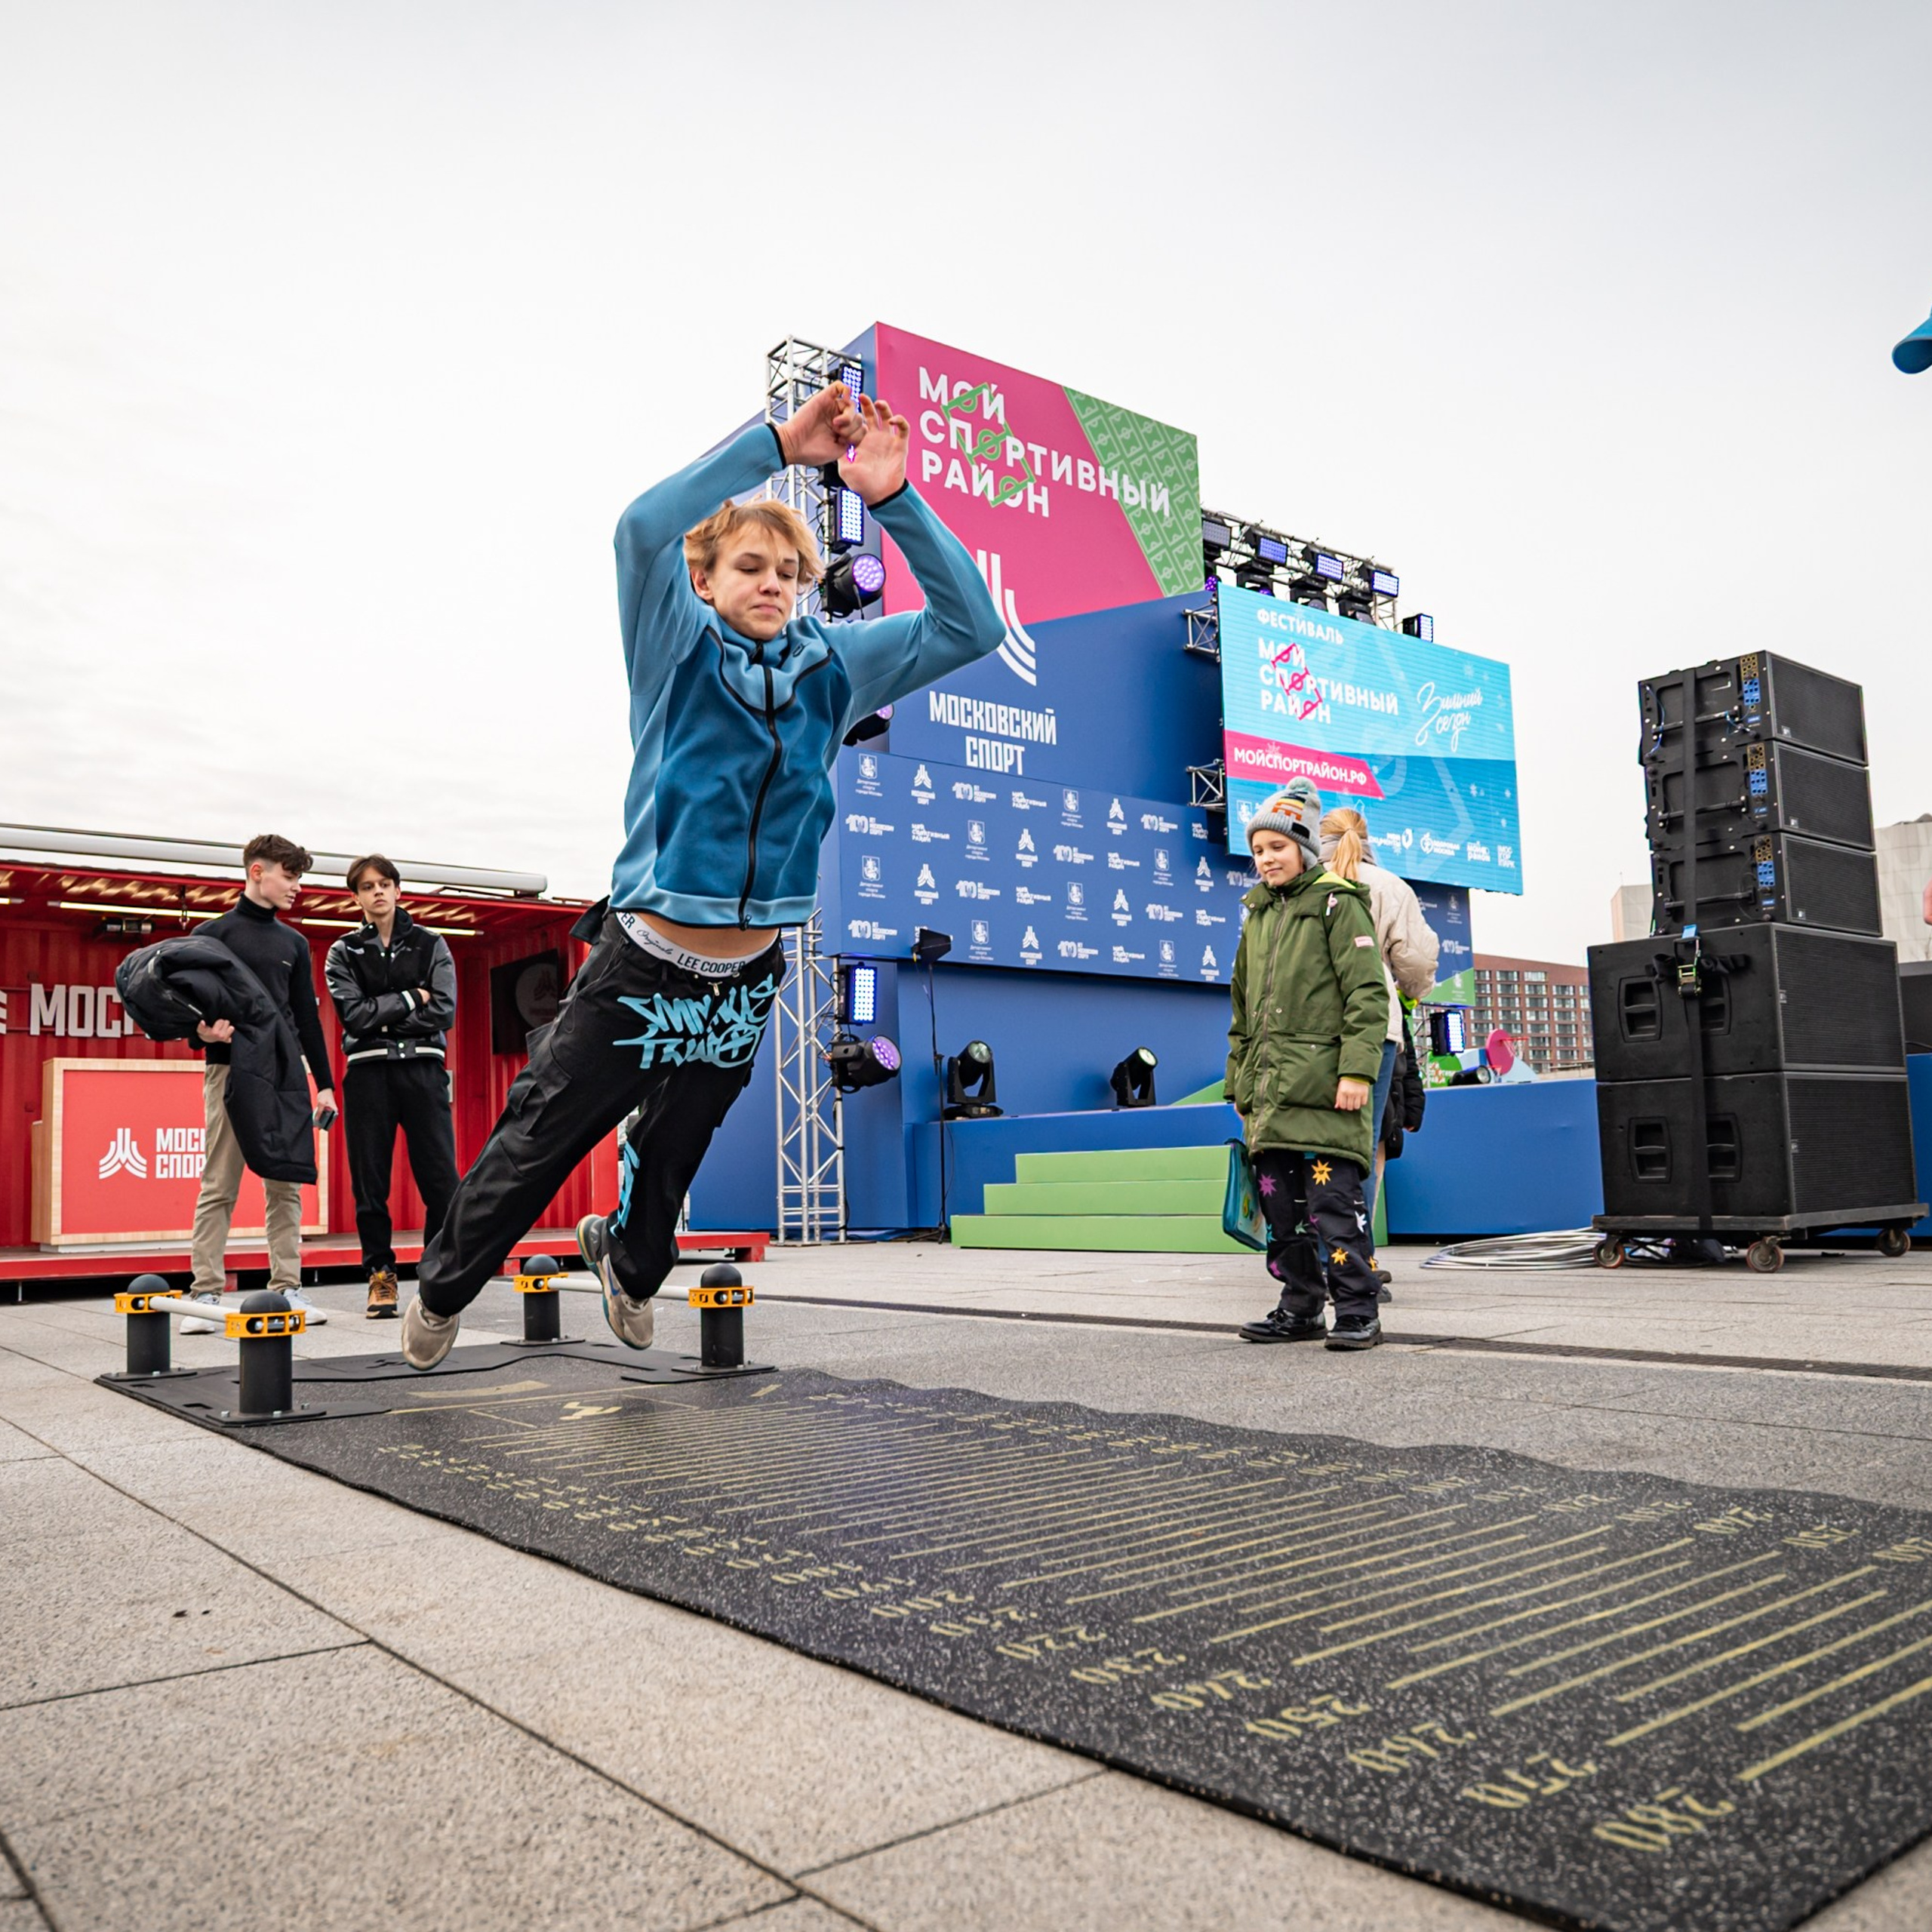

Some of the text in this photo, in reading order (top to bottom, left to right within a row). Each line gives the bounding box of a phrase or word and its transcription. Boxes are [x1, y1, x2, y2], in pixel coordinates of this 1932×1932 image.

[919, 366, 1005, 425] МОЙ
[920, 410, 1170, 517] СПОРТИВНЫЙ
[921, 450, 1050, 517] РАЙОН
[1257, 608, 1344, 645] ФЕСТИВАЛЬ
[1258, 637, 1306, 669] МОЙ
[1260, 663, 1399, 715] СПОРТИВНЫЙ
[1261, 689, 1331, 724] РАЙОН
[930, 690, 1057, 746] МОСКОВСКИЙ
[966, 736, 1025, 776] СПОРТ
[1234, 747, 1367, 786] МОЙСПОРТРАЙОН.РФ
[677, 952, 747, 974] LEE COOPER
[29, 983, 134, 1038] МОС
[869, 1589, 975, 1618] 200
[929, 1605, 1038, 1637] 210
[995, 1625, 1107, 1660] 220
[1070, 1647, 1186, 1684] 230
[1151, 1669, 1272, 1710] 240
[1245, 1693, 1371, 1740] 250
[1348, 1721, 1477, 1774] 260
[1462, 1751, 1598, 1808] 270
[1592, 1786, 1736, 1853] 280
